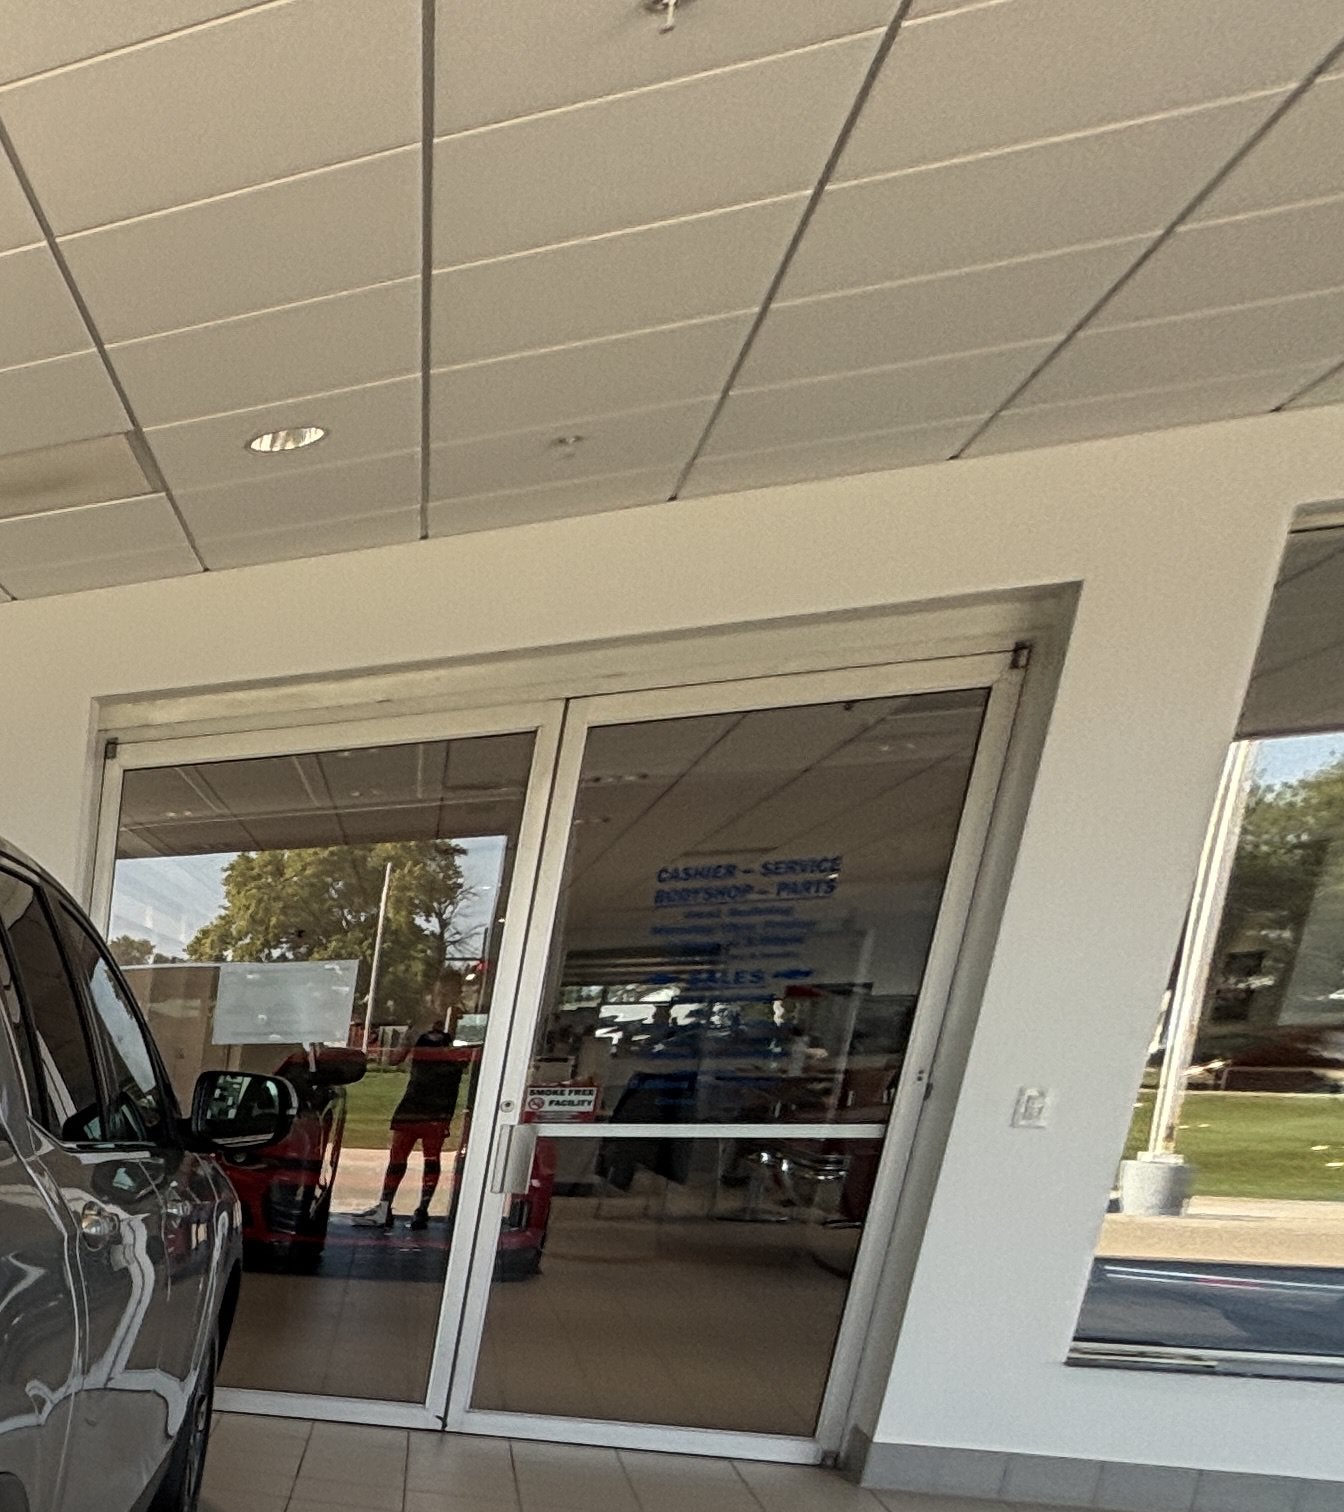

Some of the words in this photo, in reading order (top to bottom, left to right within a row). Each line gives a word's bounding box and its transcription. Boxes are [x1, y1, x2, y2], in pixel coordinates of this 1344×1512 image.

[657, 864, 737, 883] CASHIER
[760, 856, 843, 876] SERVICE
[776, 878, 838, 896] PARTS
[548, 1099, 593, 1107] FACILITY
